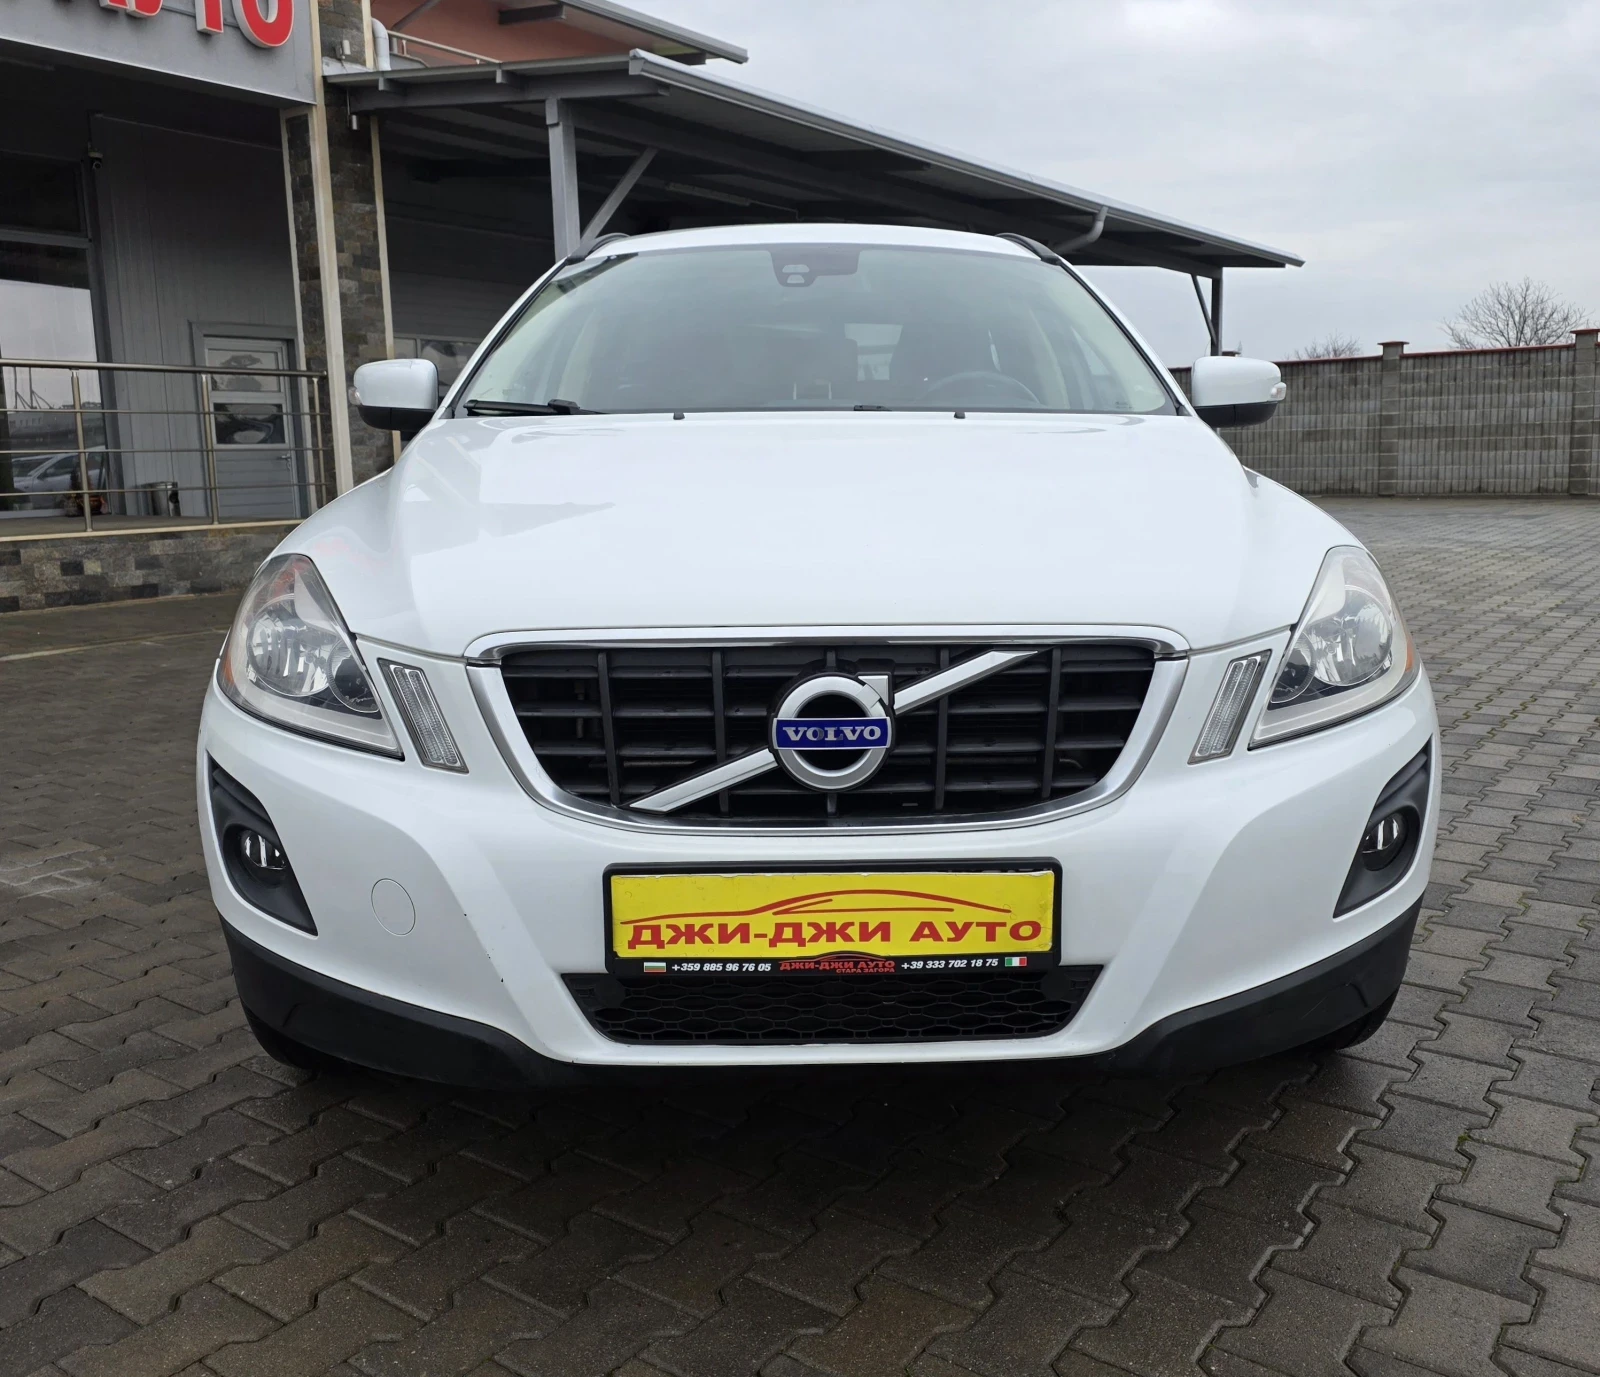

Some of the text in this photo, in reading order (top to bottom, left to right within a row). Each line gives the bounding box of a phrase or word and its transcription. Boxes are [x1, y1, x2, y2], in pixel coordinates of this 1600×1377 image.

[782, 725, 882, 741] VOLVO
[627, 920, 1042, 950] ДЖИ-ДЖИ АУТО
[671, 963, 772, 972] +359 885 96 76 05
[779, 960, 896, 971] ДЖИ-ДЖИ АУТО
[901, 958, 999, 970] +39 333 702 18 75
